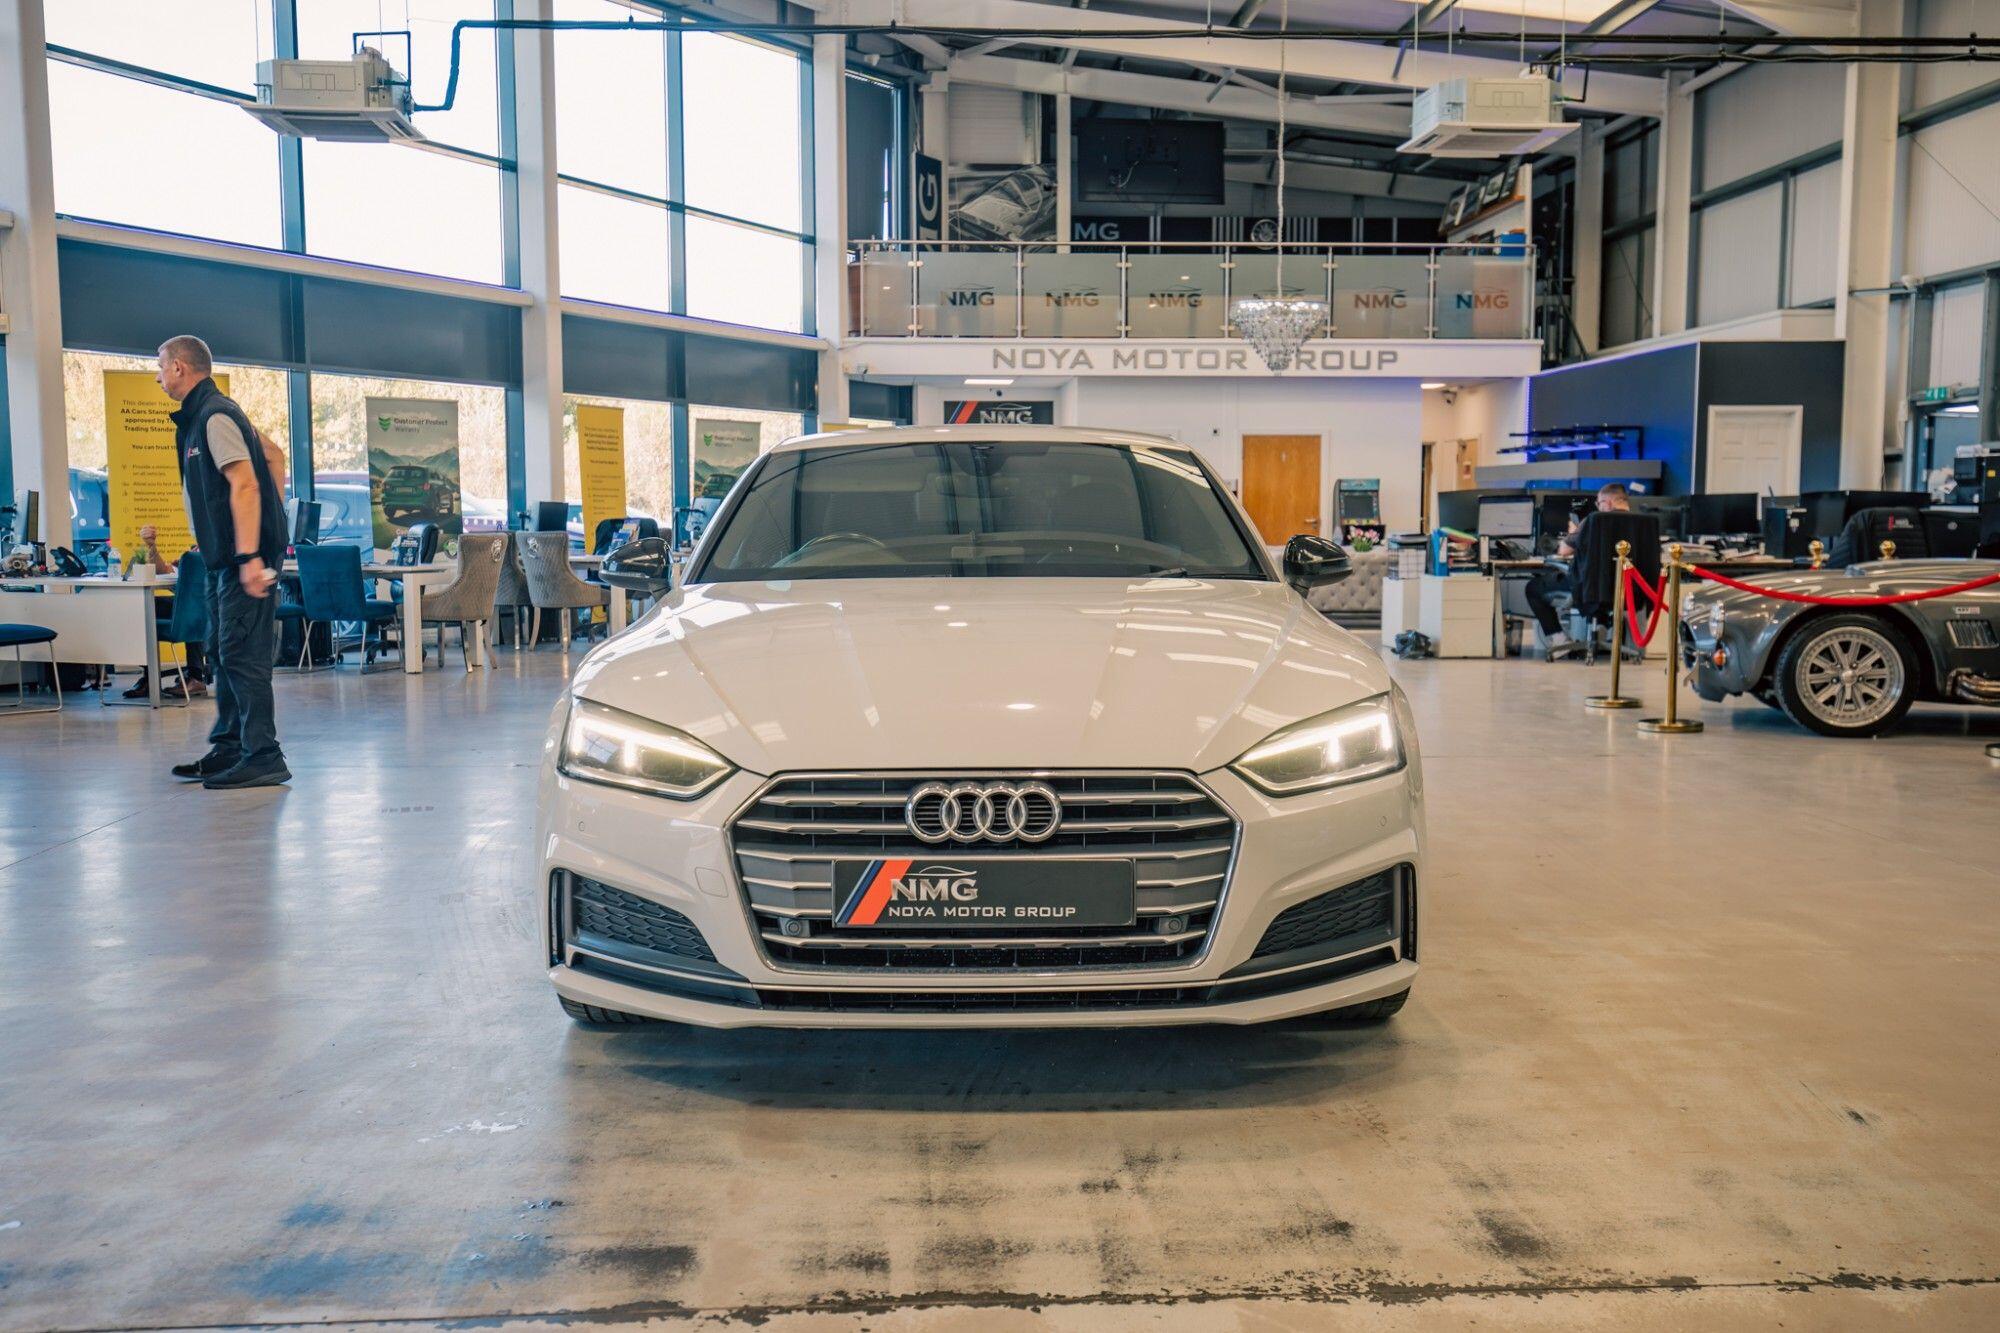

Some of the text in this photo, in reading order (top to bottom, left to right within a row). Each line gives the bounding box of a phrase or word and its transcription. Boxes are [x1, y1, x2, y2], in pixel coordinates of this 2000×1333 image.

[940, 292, 995, 306] NMG
[1046, 292, 1099, 307] NMG
[1150, 292, 1203, 308] NMG
[1354, 294, 1408, 309] NMG
[1456, 294, 1509, 309] NMG
[993, 348, 1398, 371] NOYA MOTOR ROUP
[980, 410, 1032, 424] NMG
[890, 878, 978, 901] NMG
[889, 906, 1077, 918] NOYA MOTOR GROUP
